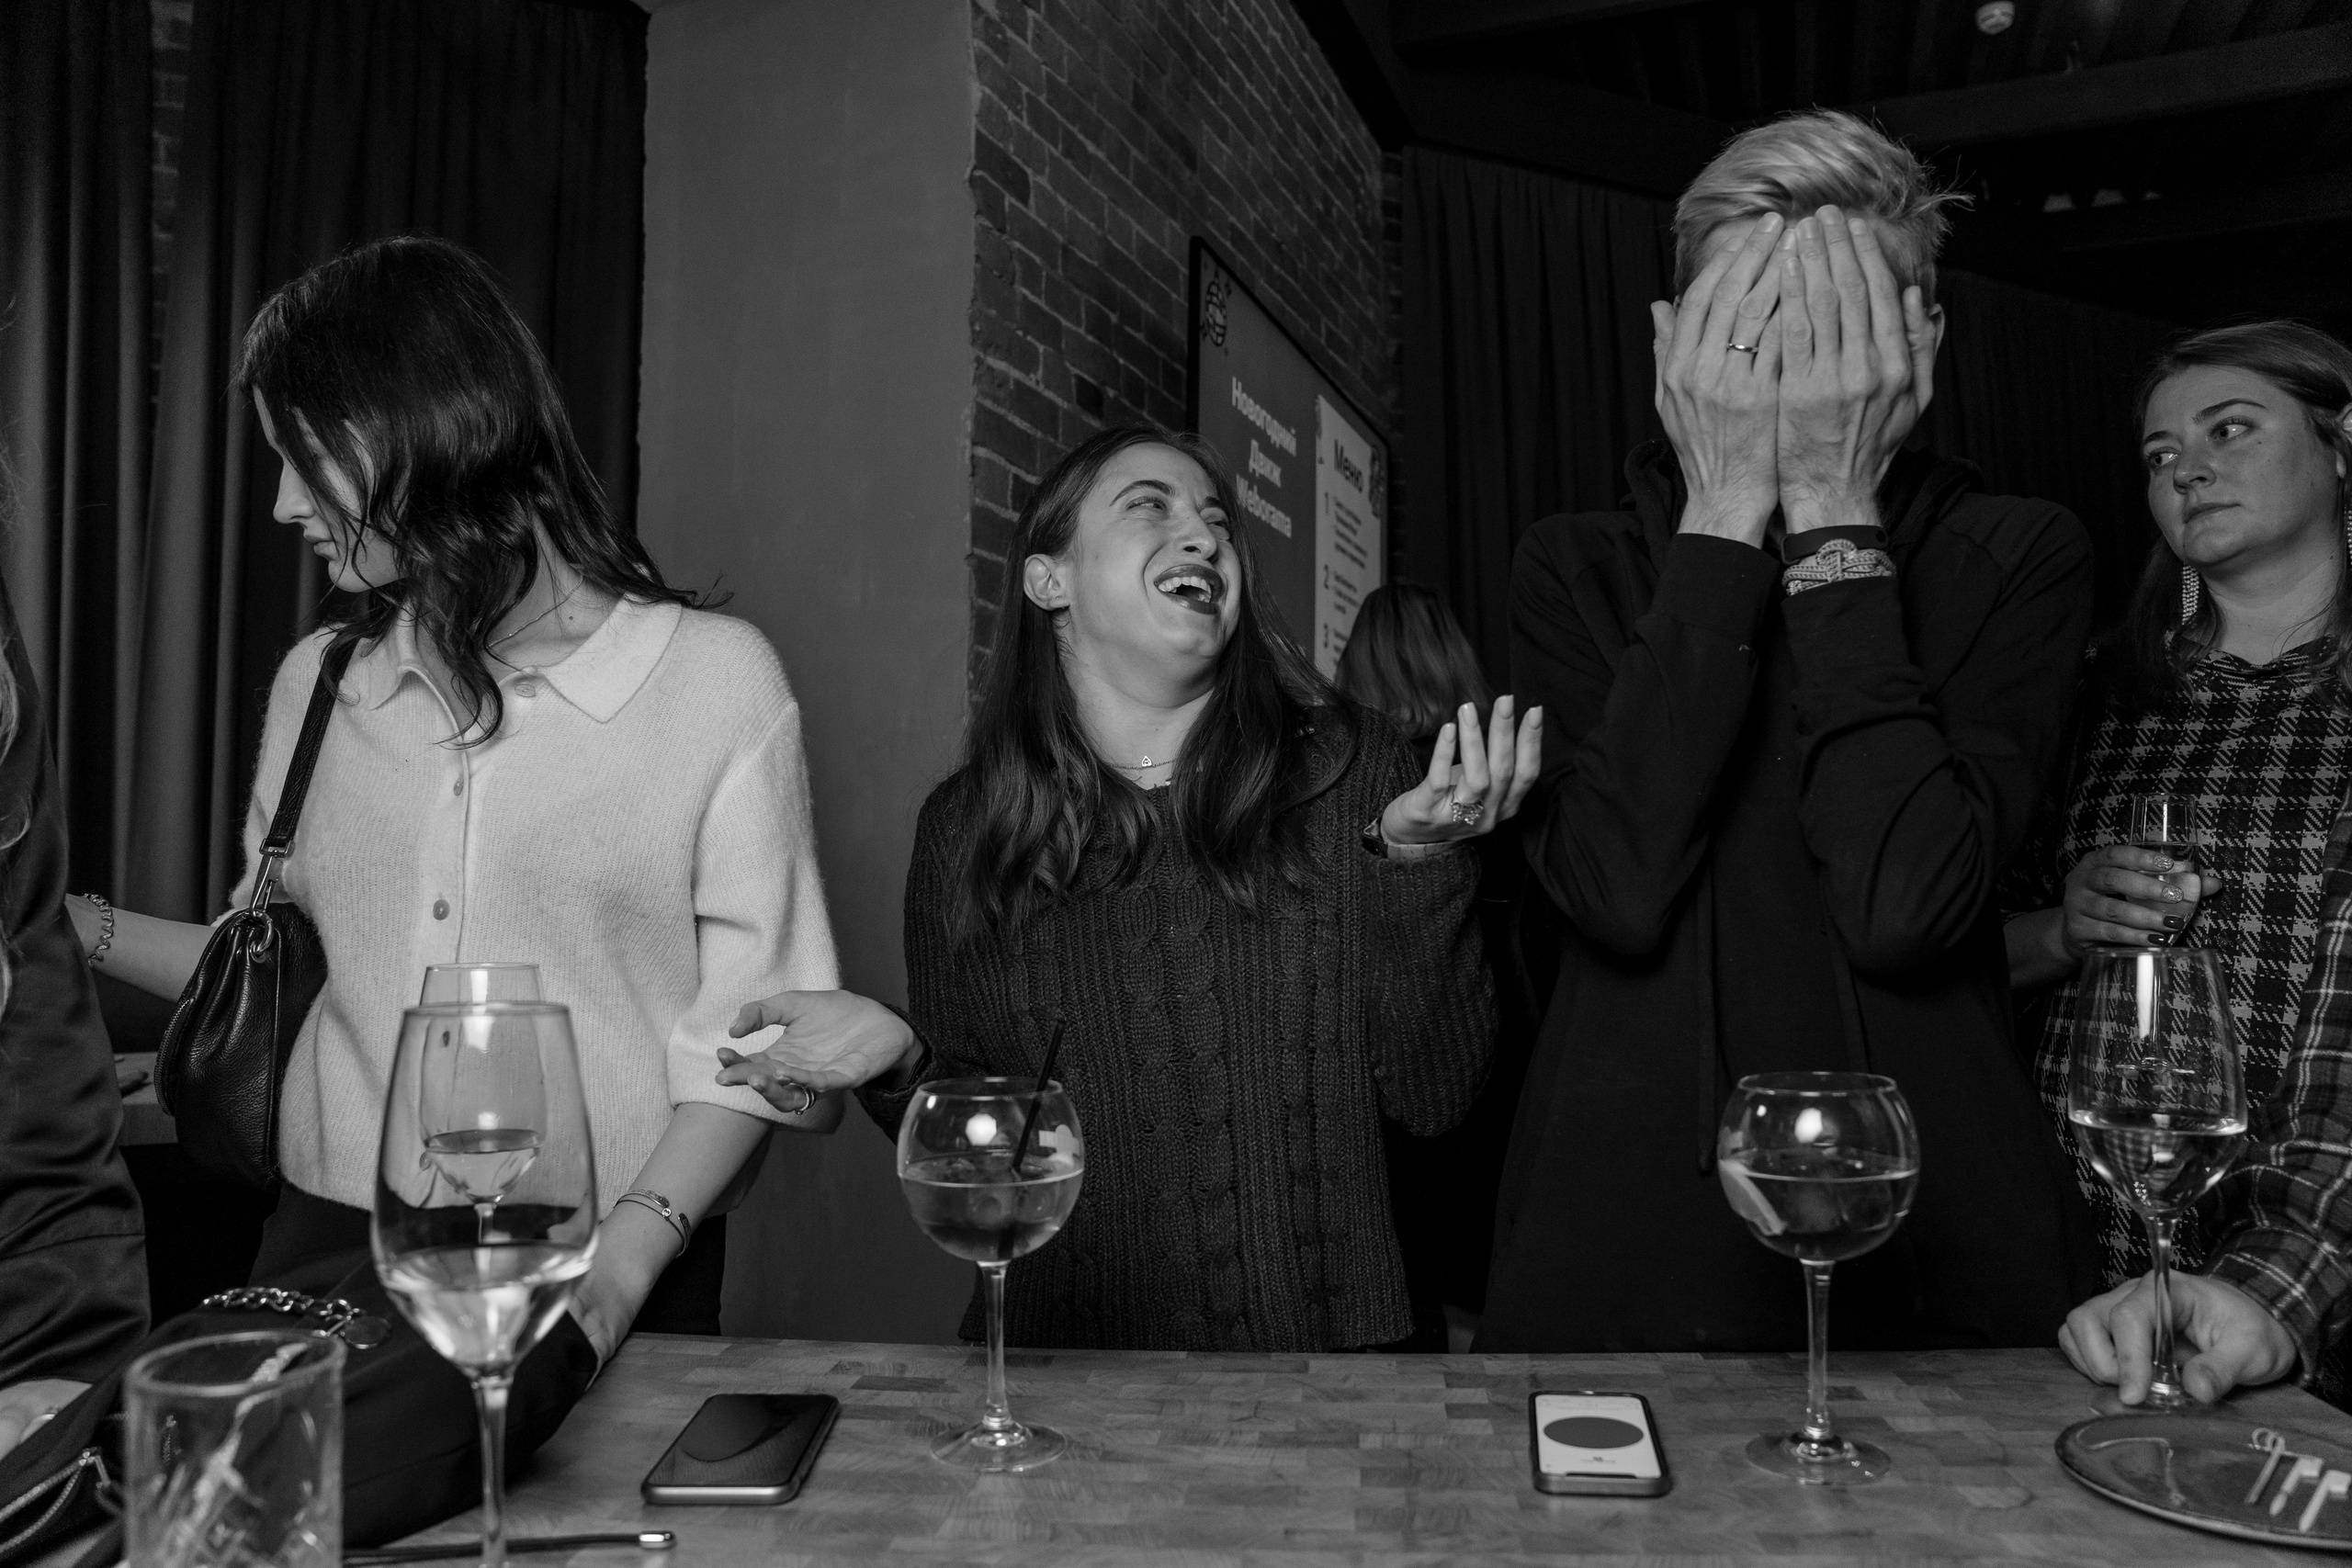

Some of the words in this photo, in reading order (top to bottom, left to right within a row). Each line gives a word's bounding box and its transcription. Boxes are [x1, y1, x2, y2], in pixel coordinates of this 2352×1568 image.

[1232, 377, 1296, 457] Новогодний
[1334, 439, 1364, 493] Меню
[1236, 474, 1293, 539] Weborama
[1324, 492, 1329, 515] 1
[1324, 564, 1329, 589] 2
